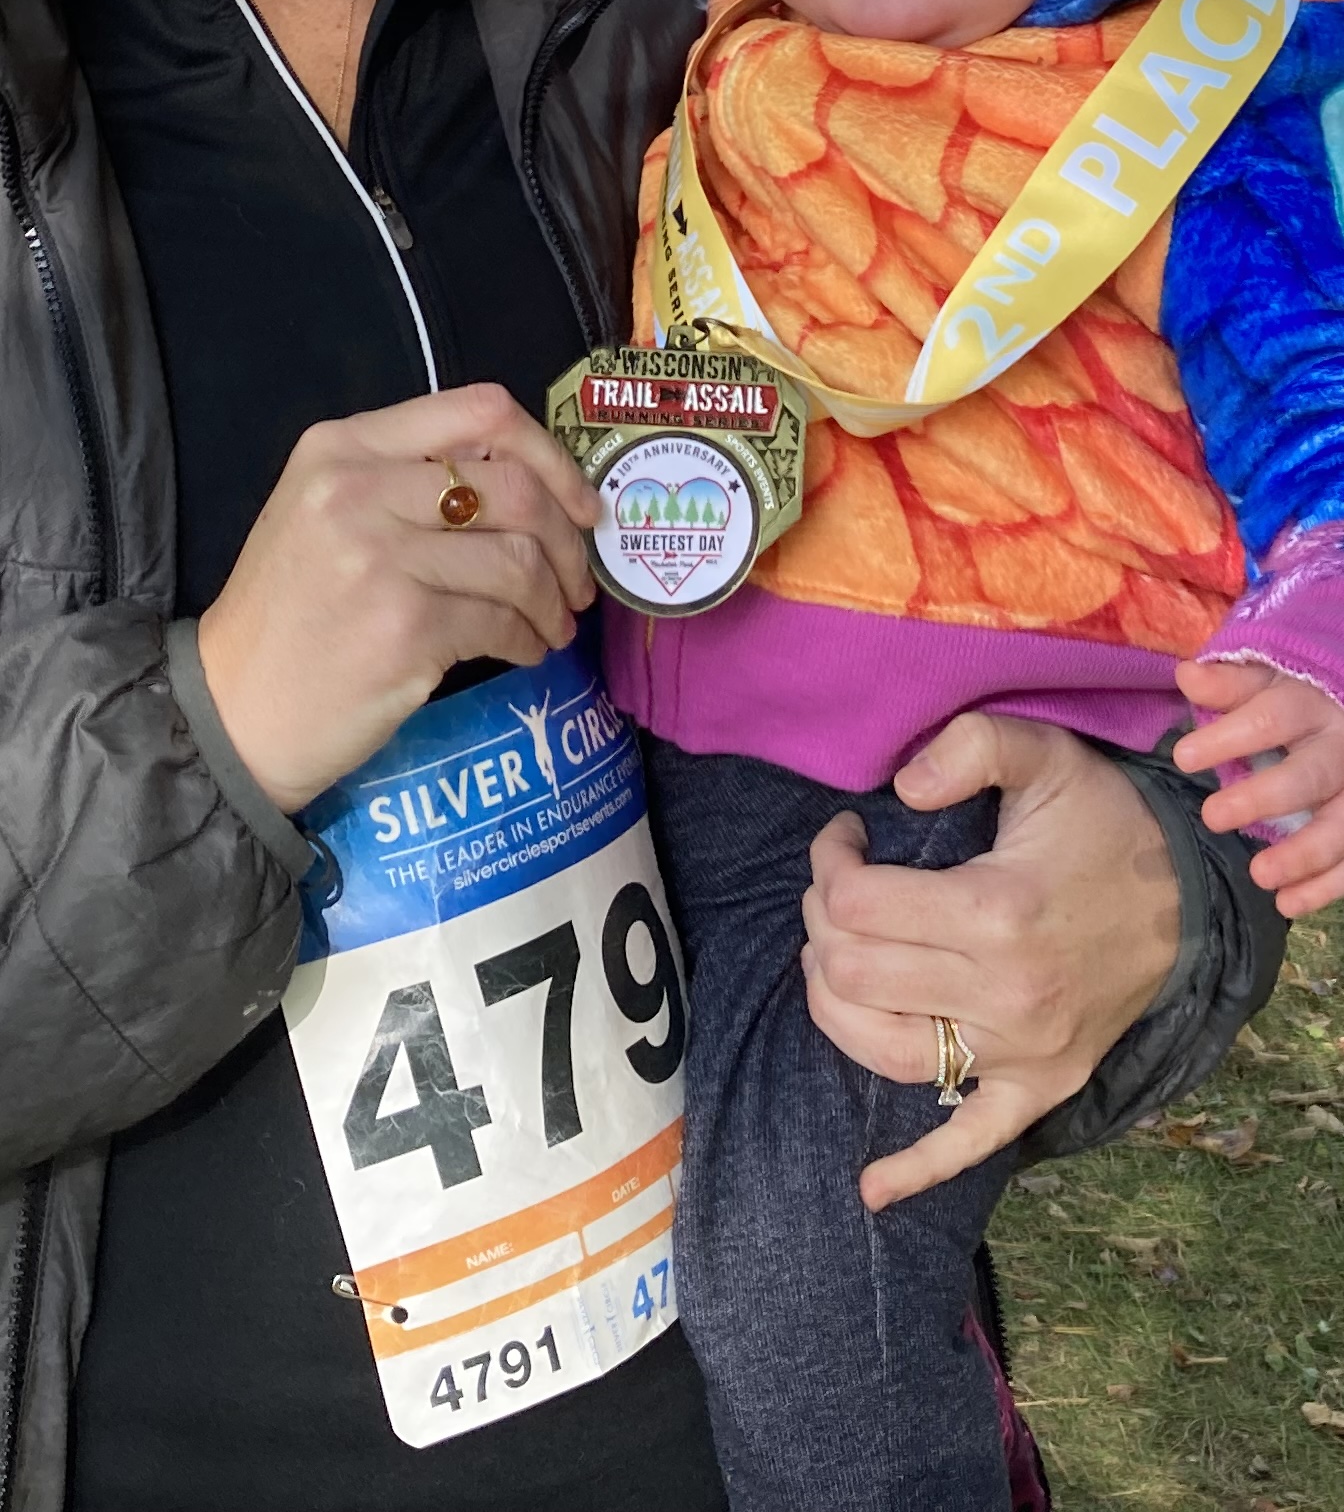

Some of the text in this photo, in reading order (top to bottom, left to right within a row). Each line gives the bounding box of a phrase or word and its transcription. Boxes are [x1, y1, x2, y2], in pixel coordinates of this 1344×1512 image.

[944, 218, 1062, 361] 2ND
[590, 379, 769, 414] TRAIL ASSAIL
[622, 350, 743, 381] WISCONSIN
[592, 432, 624, 466] CIRCLE
[643, 442, 731, 477] ANNIVERSARY
[724, 434, 774, 511] SPORTS EVENTS
[620, 534, 724, 551] SWEETEST DAY
[369, 750, 531, 843] SILVER
[385, 860, 430, 888] THE
[436, 830, 508, 875] LEADER
[511, 818, 534, 842] IN
[538, 775, 618, 831] ENDURANCE
[453, 788, 633, 891] silvercirclesportsevents.com
[343, 881, 690, 1191] 479
[611, 1176, 641, 1203] DATE:
[465, 1242, 514, 1270] NAME:
[632, 1258, 670, 1321] 47
[430, 1325, 562, 1412] 4791
